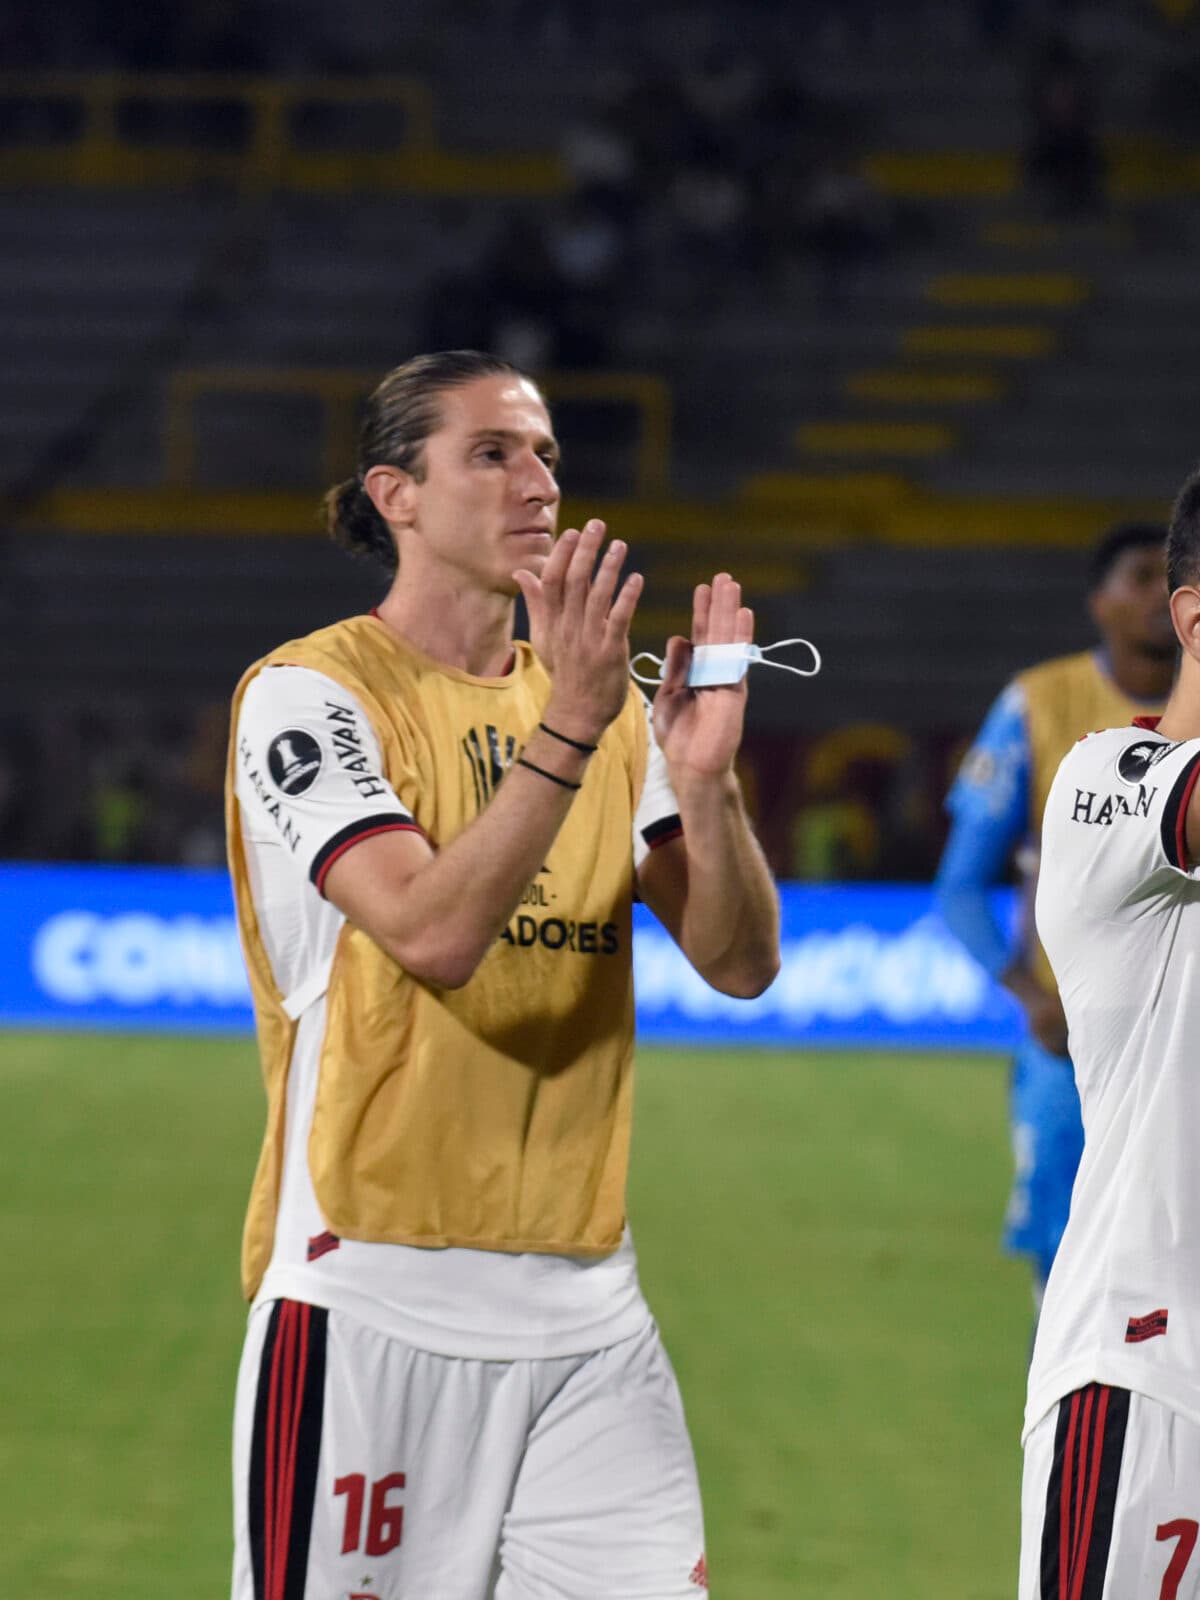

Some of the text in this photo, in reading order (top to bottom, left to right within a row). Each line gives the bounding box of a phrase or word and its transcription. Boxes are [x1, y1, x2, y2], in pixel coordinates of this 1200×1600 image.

[324, 701, 386, 798] HAVAN
[333, 1472, 406, 1557] 16
[1155, 1518, 1199, 1600] 7
